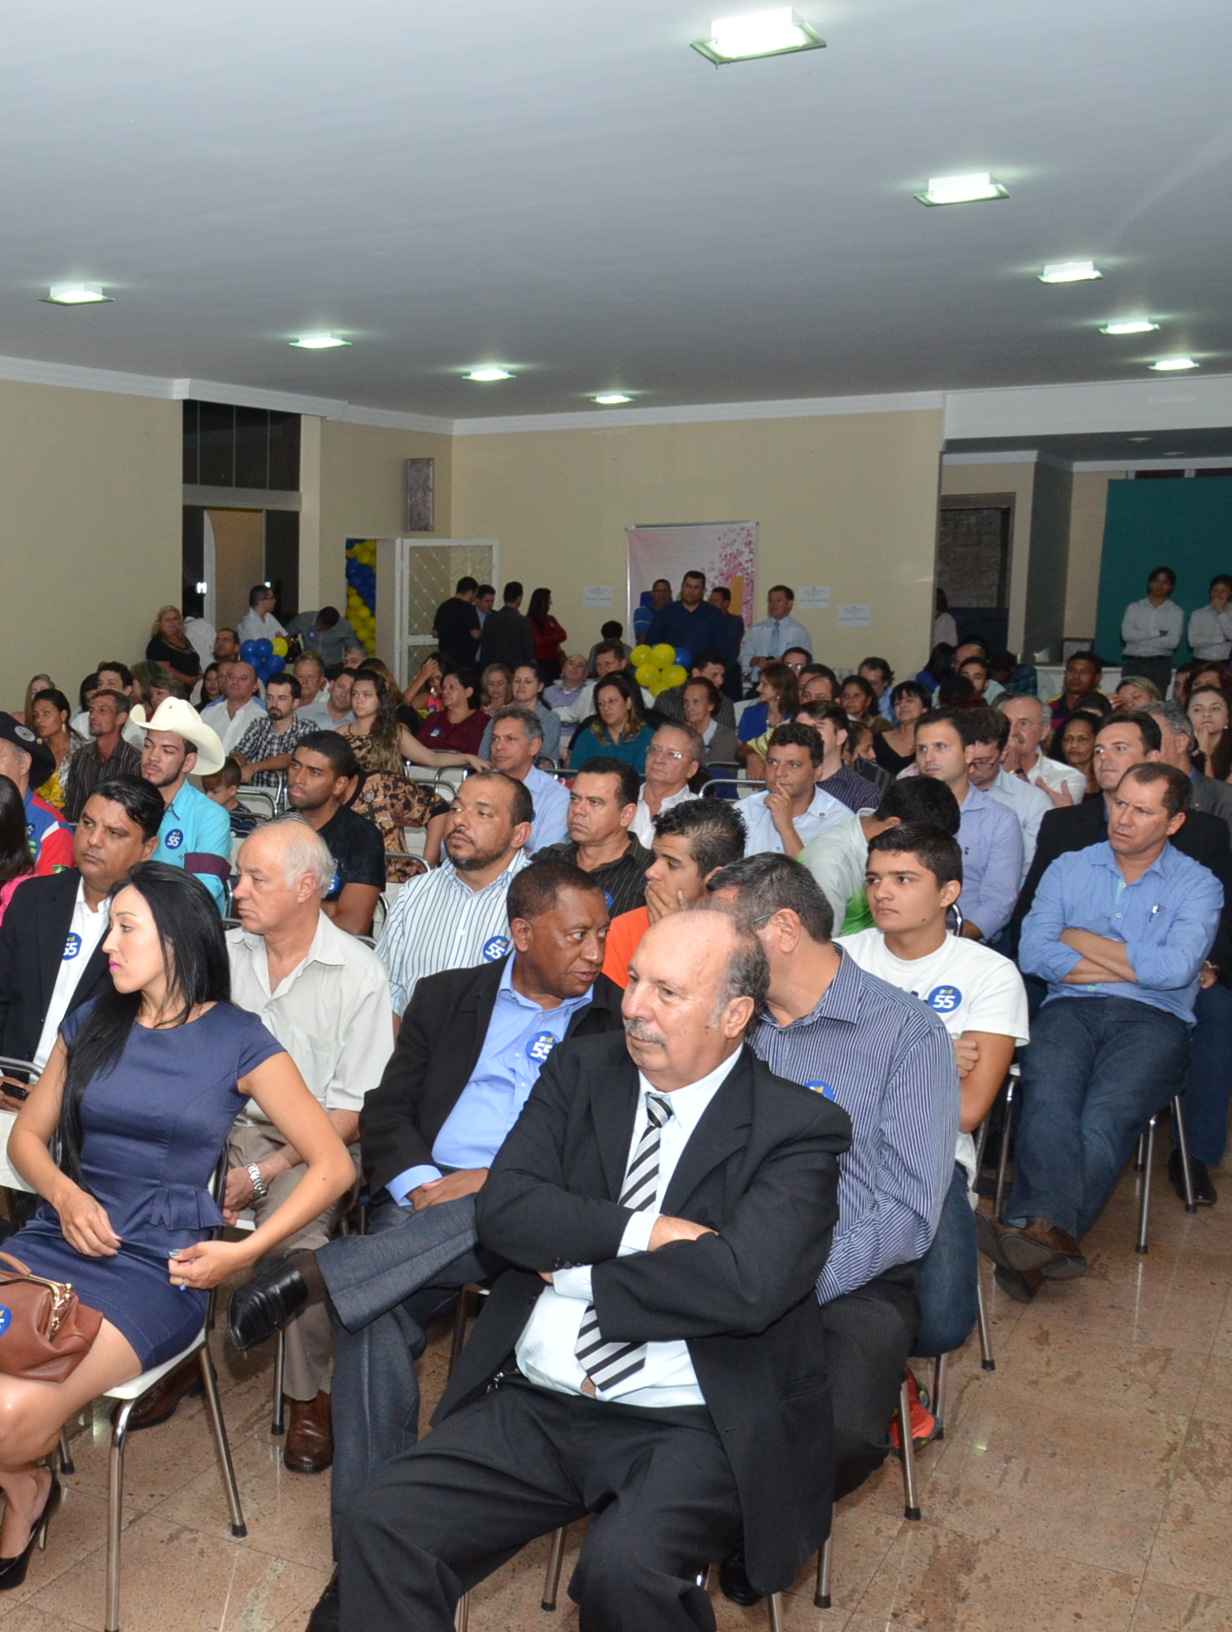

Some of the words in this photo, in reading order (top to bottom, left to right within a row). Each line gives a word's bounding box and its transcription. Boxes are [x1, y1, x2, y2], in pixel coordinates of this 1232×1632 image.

[167, 835, 181, 847] 55
[485, 942, 505, 960] 55
[933, 994, 956, 1009] 55
[530, 1041, 553, 1060] 55
